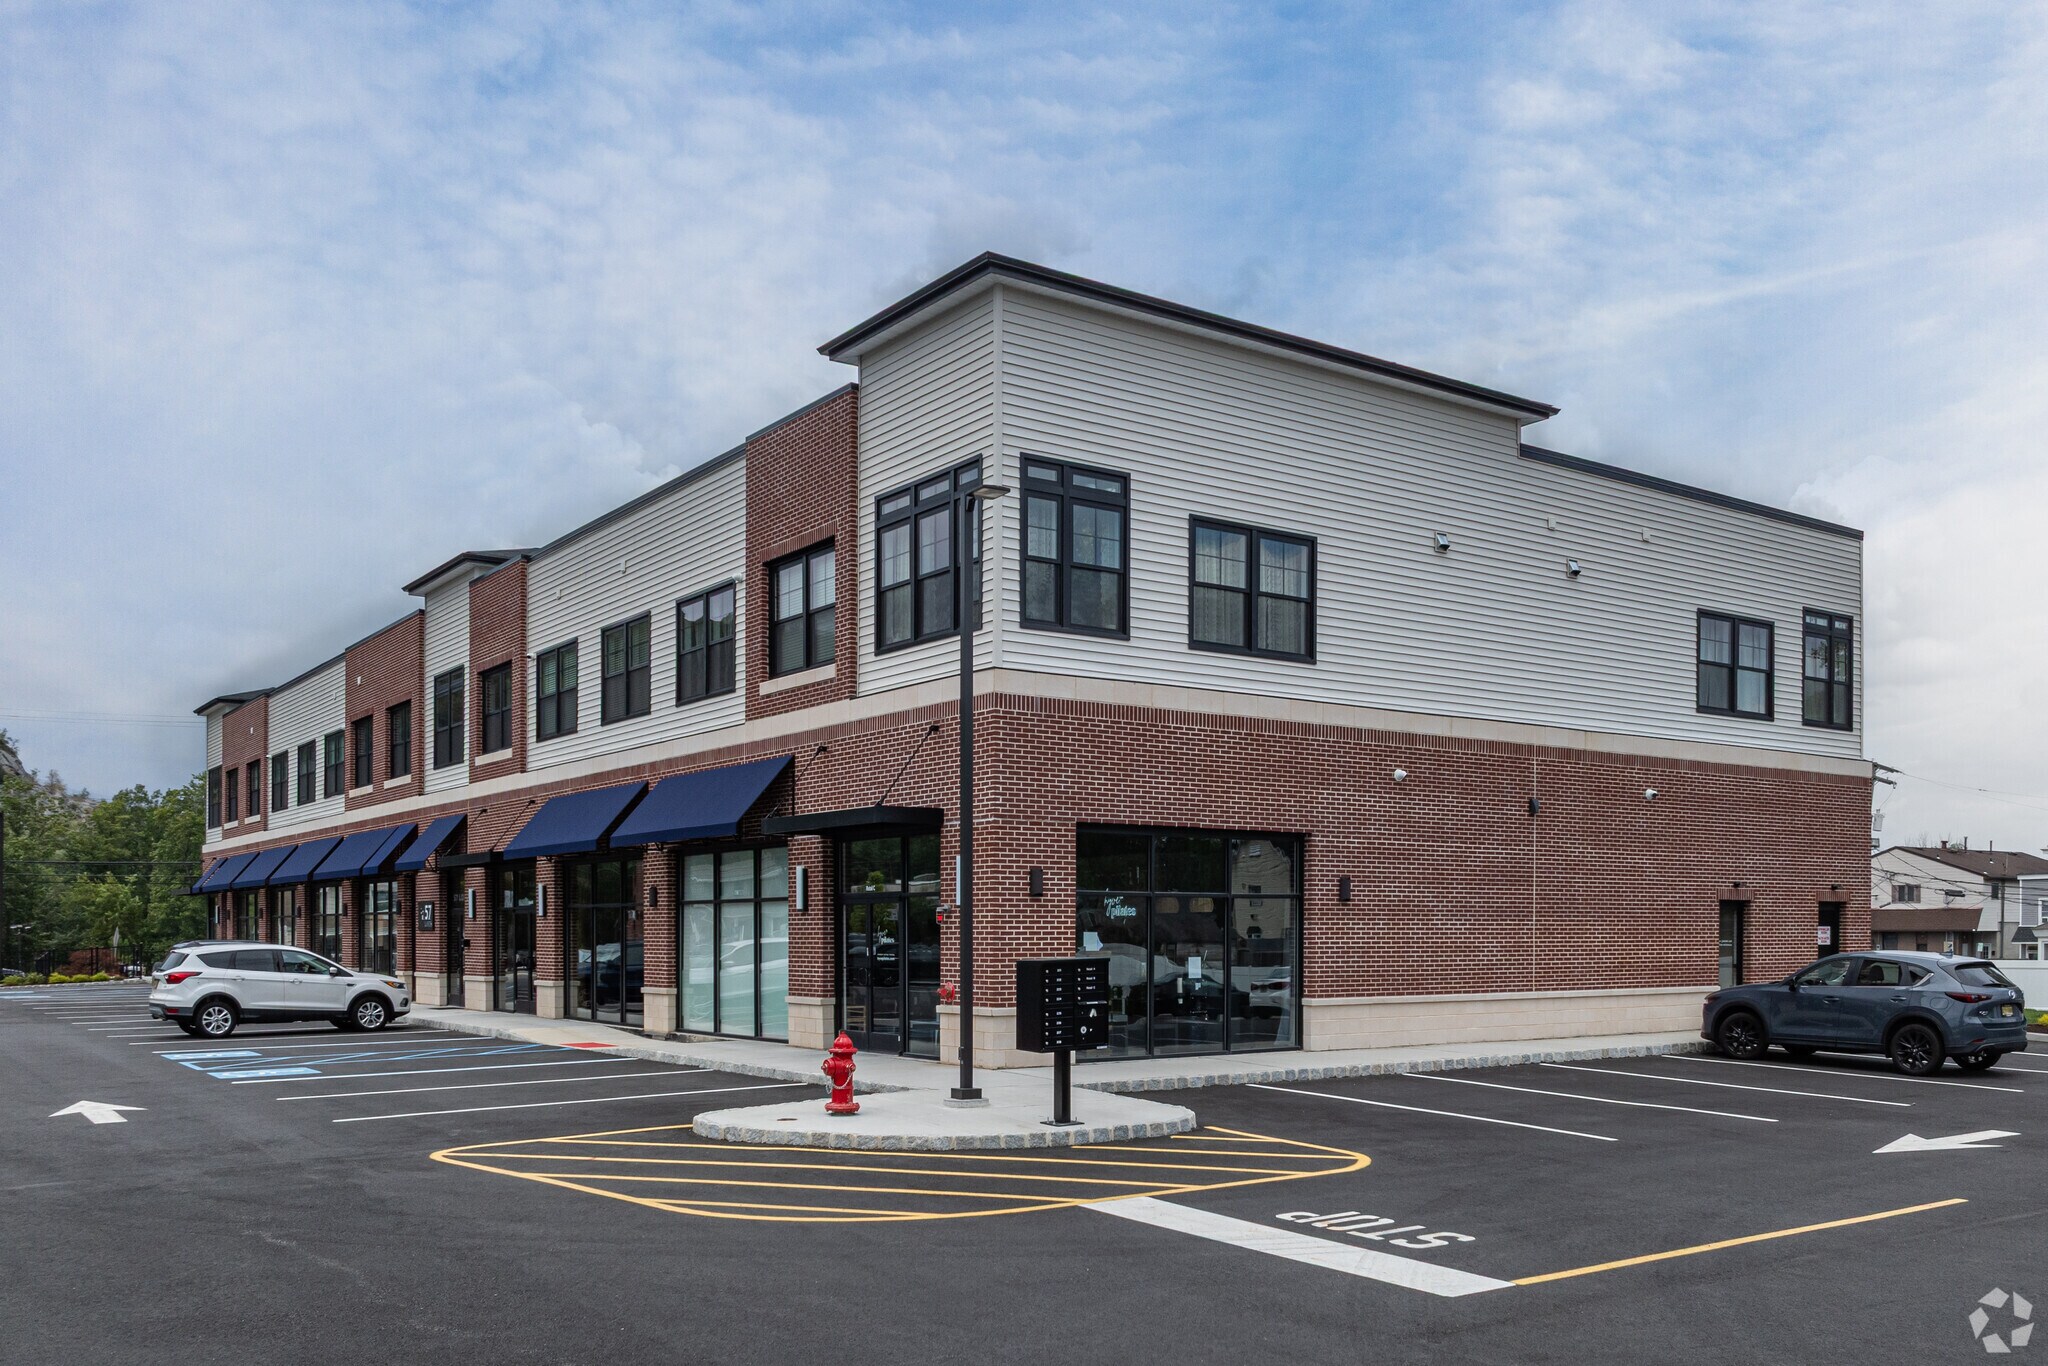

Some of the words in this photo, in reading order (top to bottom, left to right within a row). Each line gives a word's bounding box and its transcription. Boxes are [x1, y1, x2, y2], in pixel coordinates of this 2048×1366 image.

[424, 905, 432, 920] 57
[1110, 905, 1137, 920] pilates
[1275, 1211, 1476, 1249] STOP
